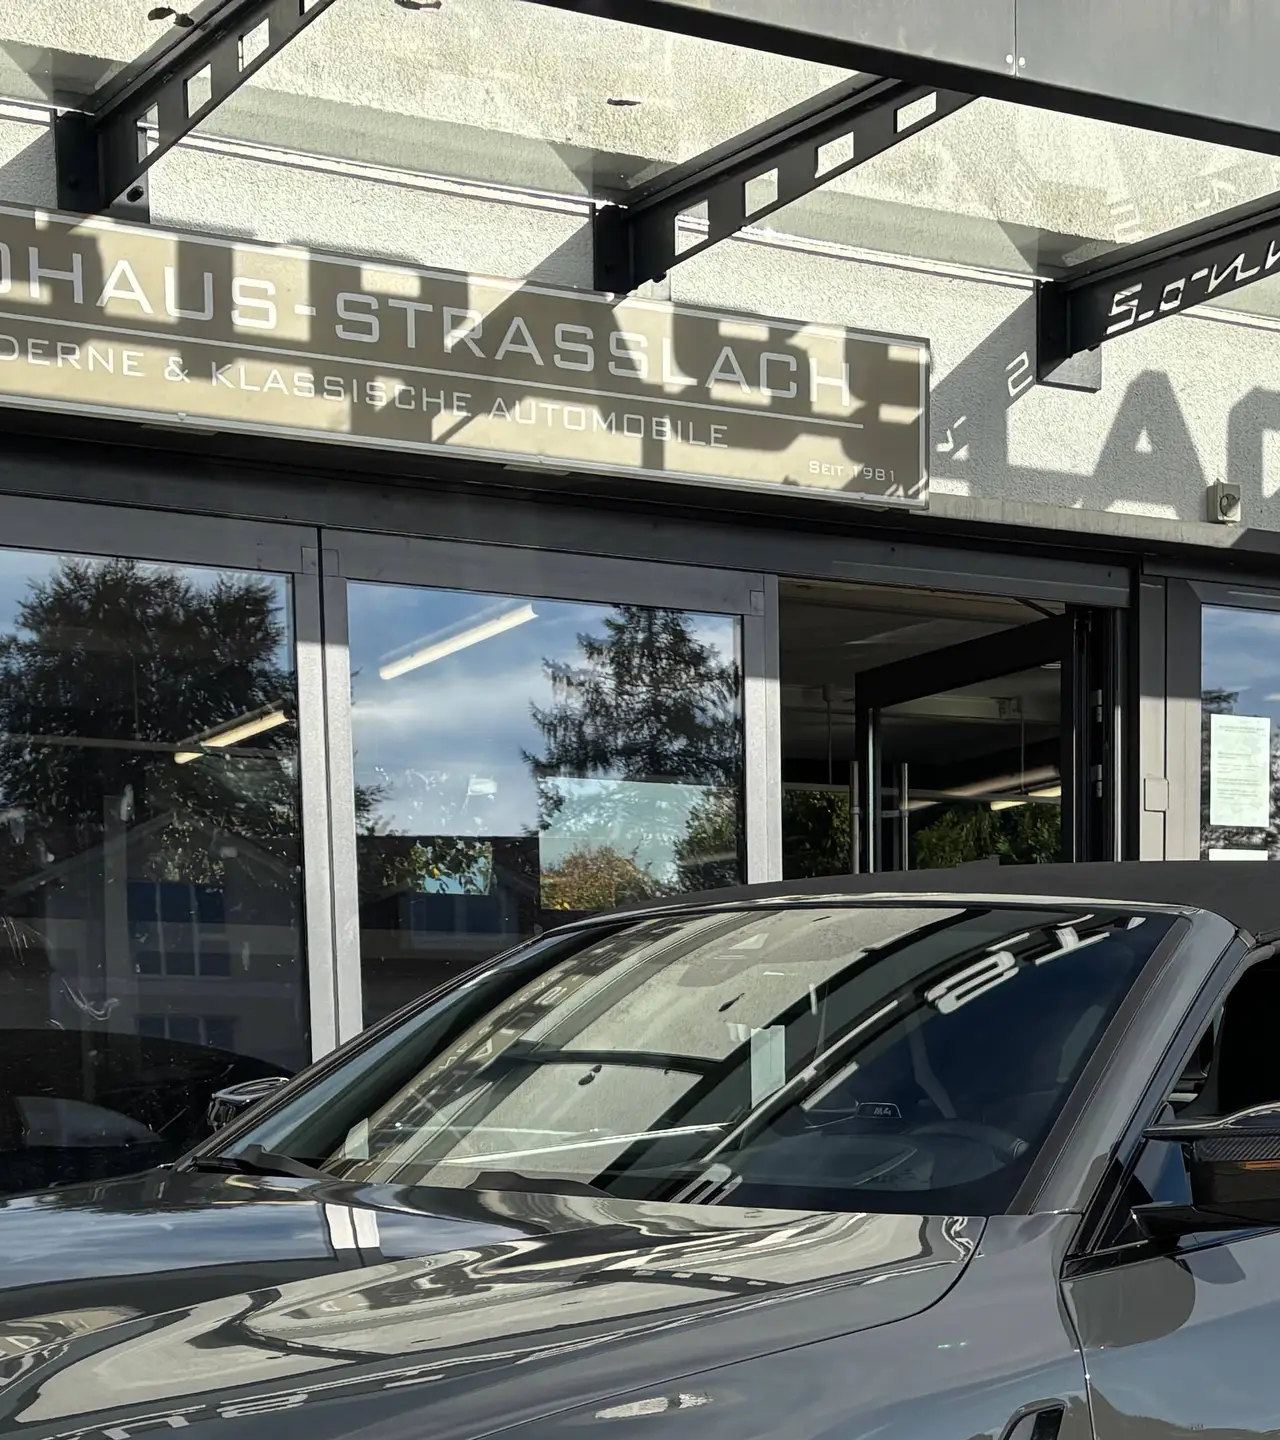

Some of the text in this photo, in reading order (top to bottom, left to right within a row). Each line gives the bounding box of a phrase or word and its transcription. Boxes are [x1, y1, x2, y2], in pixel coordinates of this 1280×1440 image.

[163, 356, 191, 384] &
[211, 361, 472, 418] KLASSISCHE
[488, 397, 729, 448] AUTOMOBILE
[851, 463, 896, 482] 1981
